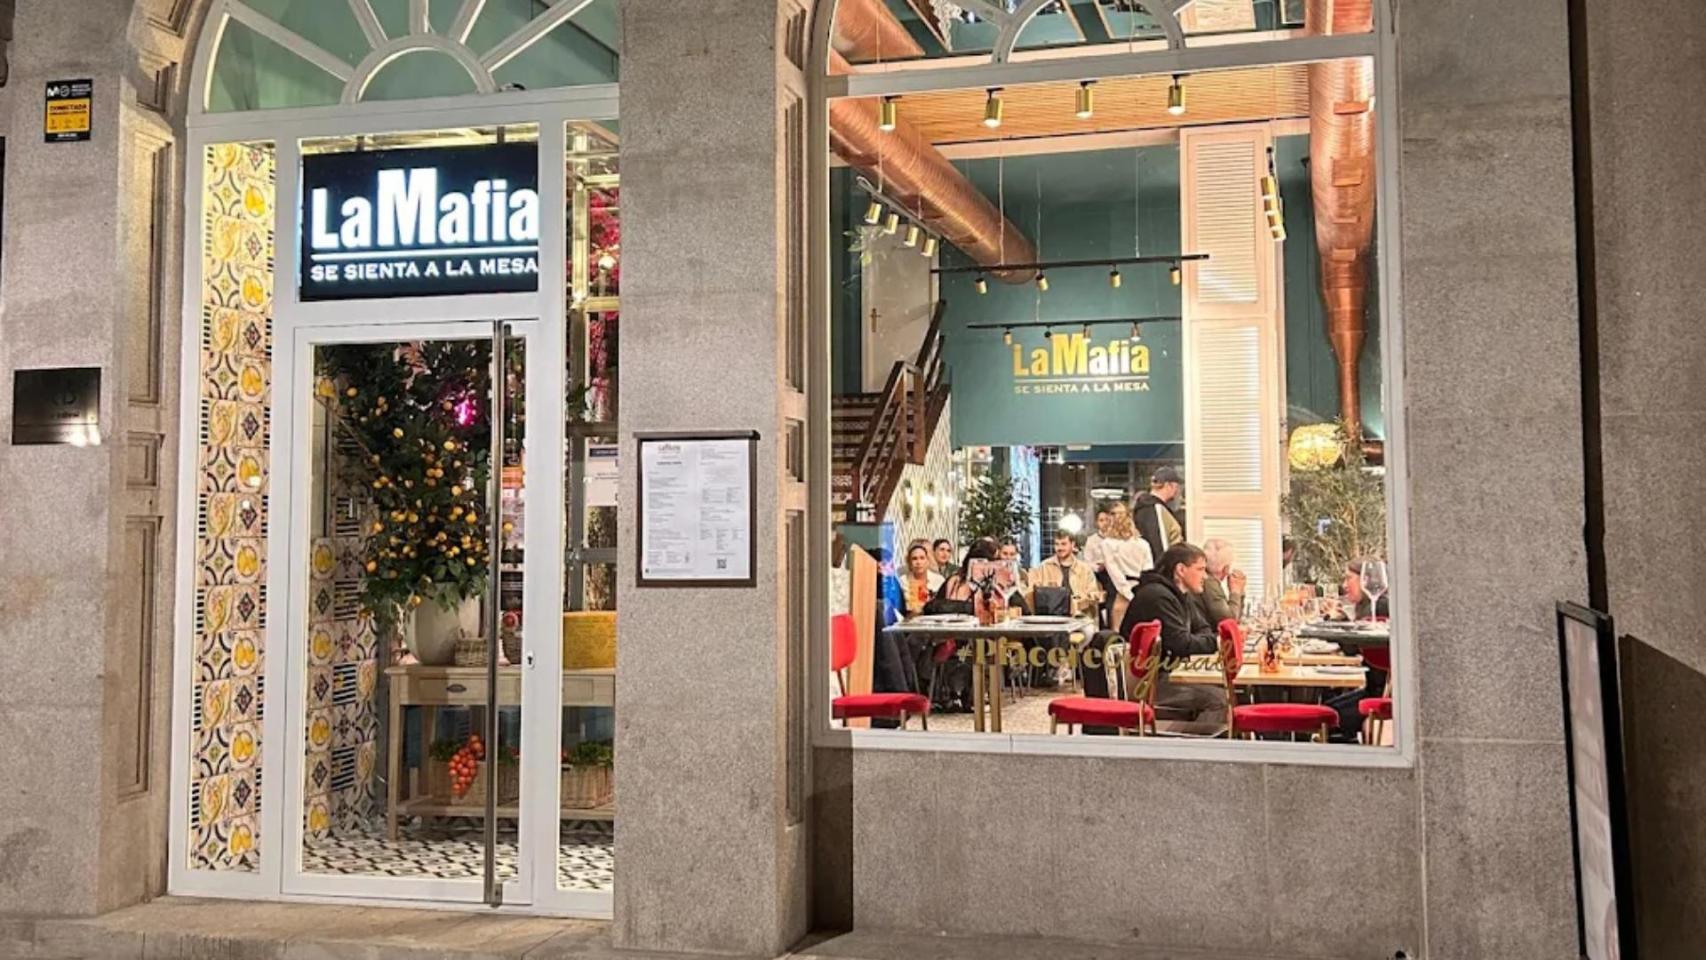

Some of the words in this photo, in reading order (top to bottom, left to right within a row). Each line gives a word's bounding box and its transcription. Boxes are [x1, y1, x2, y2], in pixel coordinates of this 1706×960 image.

[311, 167, 539, 249] LaMafia
[311, 264, 338, 282] SE
[344, 262, 420, 280] SIENTA
[425, 262, 440, 276] A
[446, 260, 473, 276] LA
[480, 257, 539, 275] MESA
[1013, 333, 1150, 377] LaMafia
[1014, 384, 1030, 394] SE
[1034, 384, 1078, 394] SIENTA
[1081, 383, 1091, 393] A
[1093, 382, 1111, 393] LA
[1113, 381, 1150, 392] MESA
